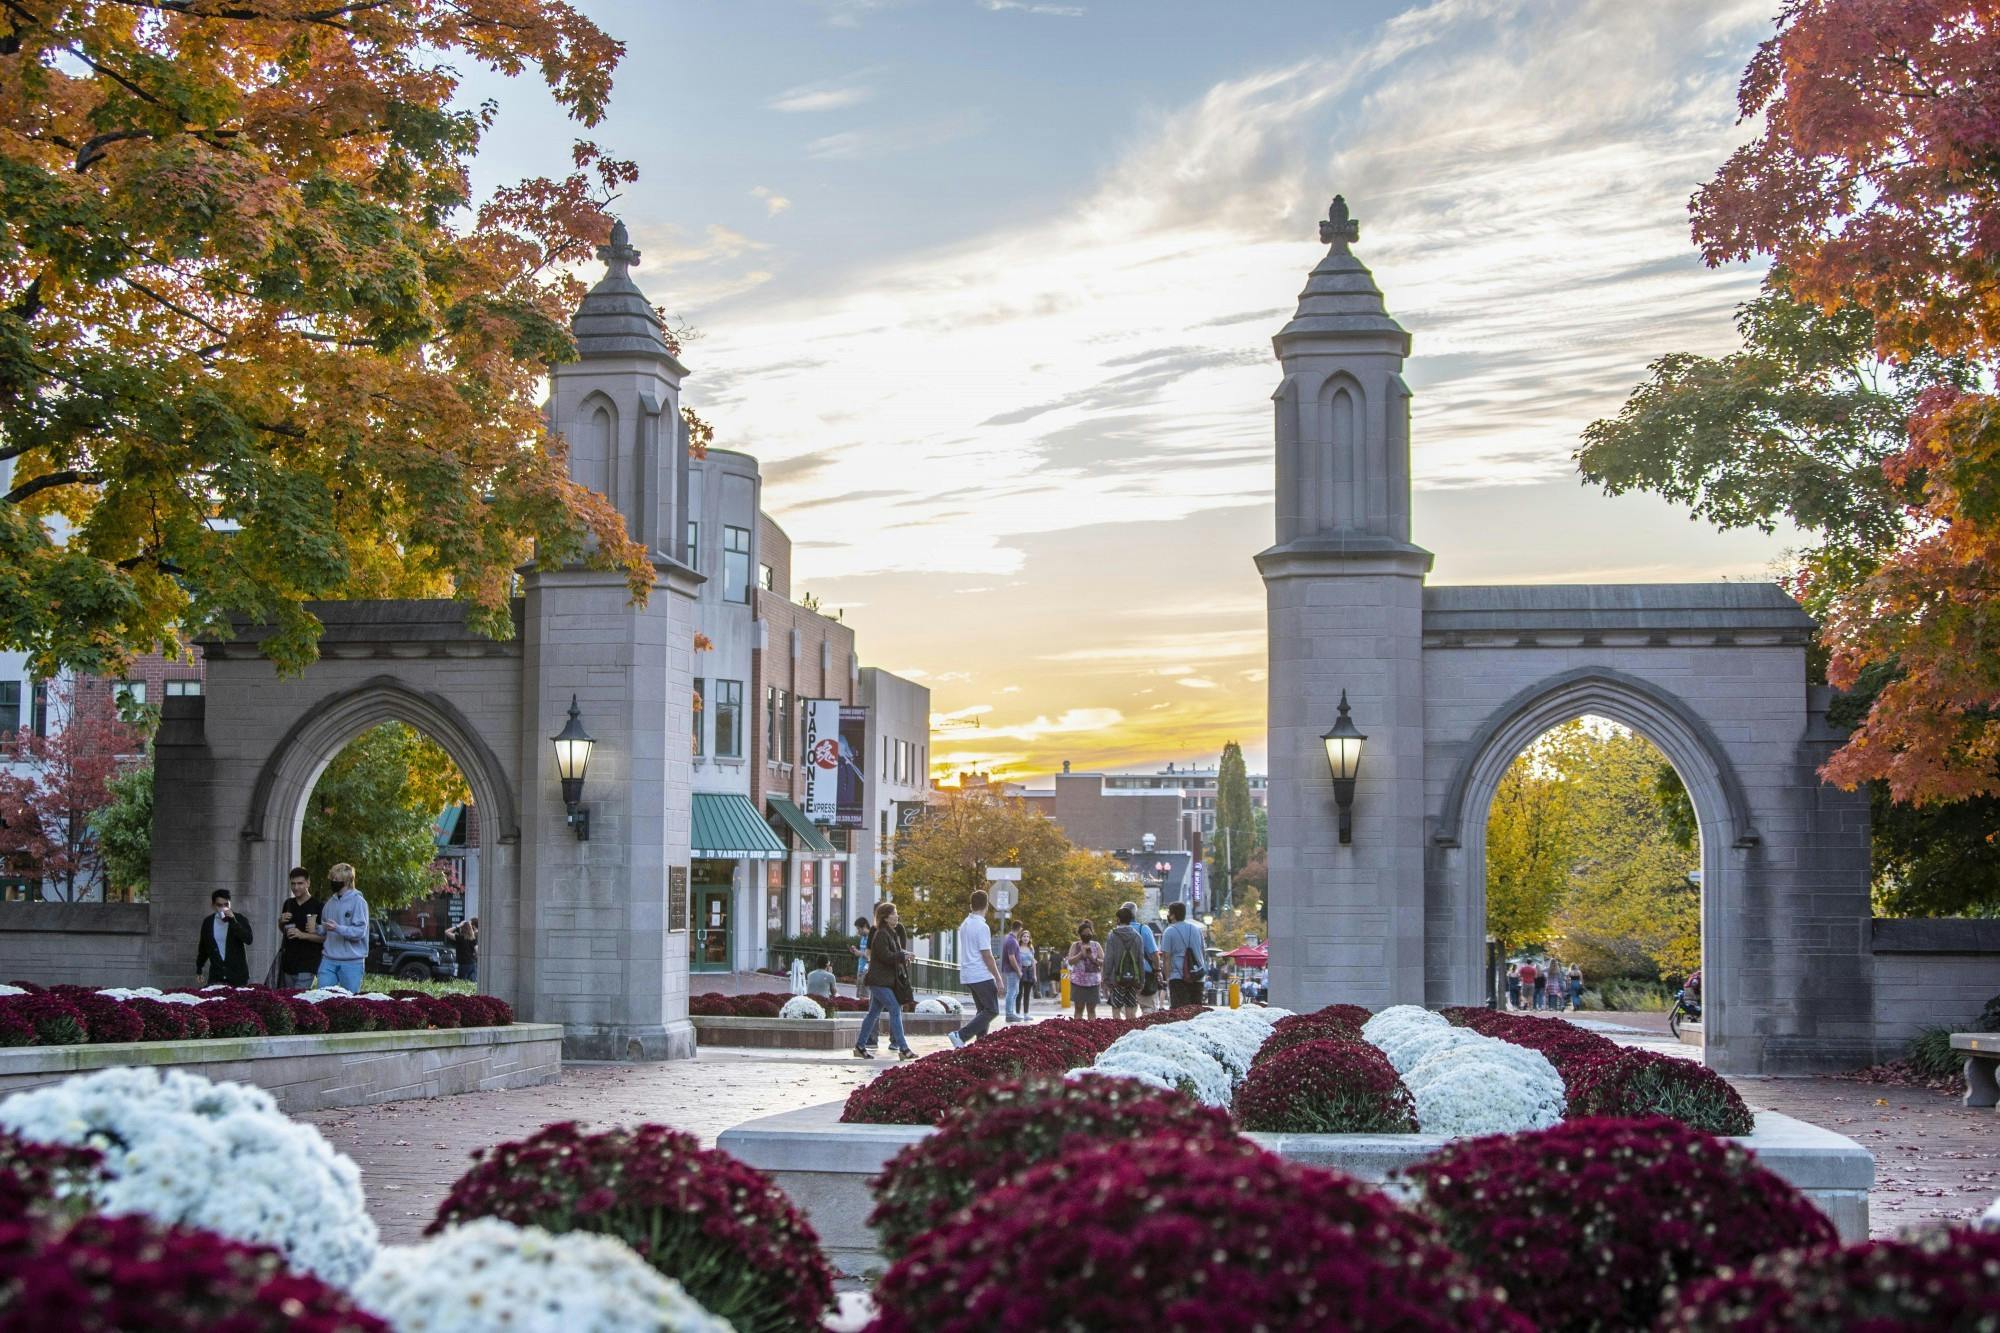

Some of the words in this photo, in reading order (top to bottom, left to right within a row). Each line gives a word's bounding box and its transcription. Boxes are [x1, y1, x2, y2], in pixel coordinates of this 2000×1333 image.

[706, 849, 715, 858] IU
[717, 849, 748, 858] VARSITY
[749, 850, 765, 858] SHOP
